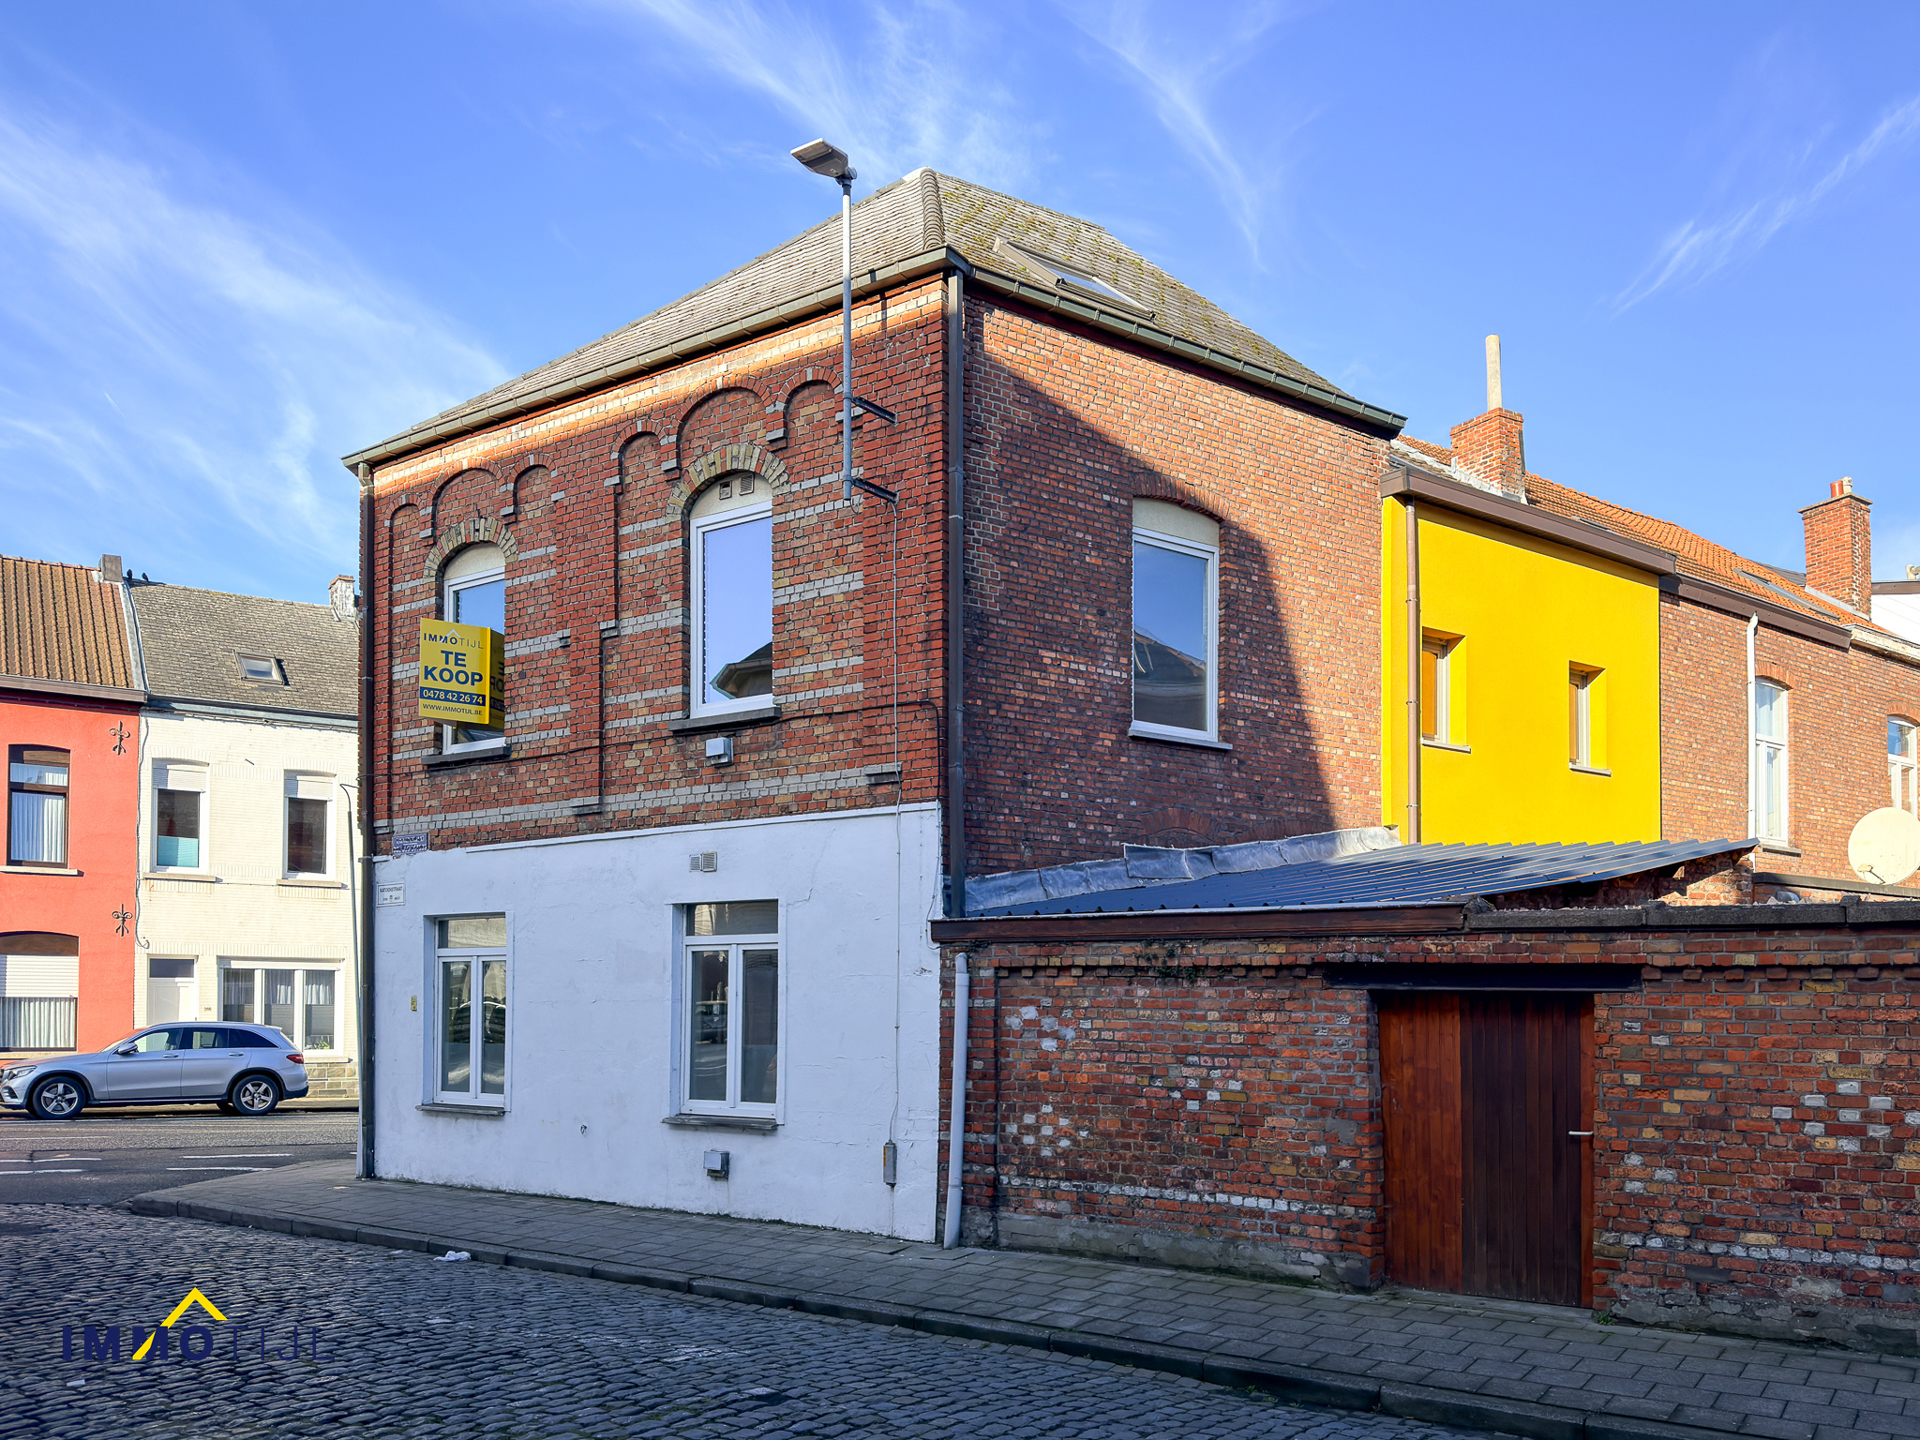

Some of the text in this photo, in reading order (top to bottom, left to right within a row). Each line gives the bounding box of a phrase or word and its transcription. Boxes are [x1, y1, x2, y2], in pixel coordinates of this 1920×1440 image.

[424, 633, 484, 649] IMMOTIJL
[441, 650, 467, 668] TE
[424, 665, 484, 686] KOOP
[423, 689, 483, 704] 0478 42 26 74
